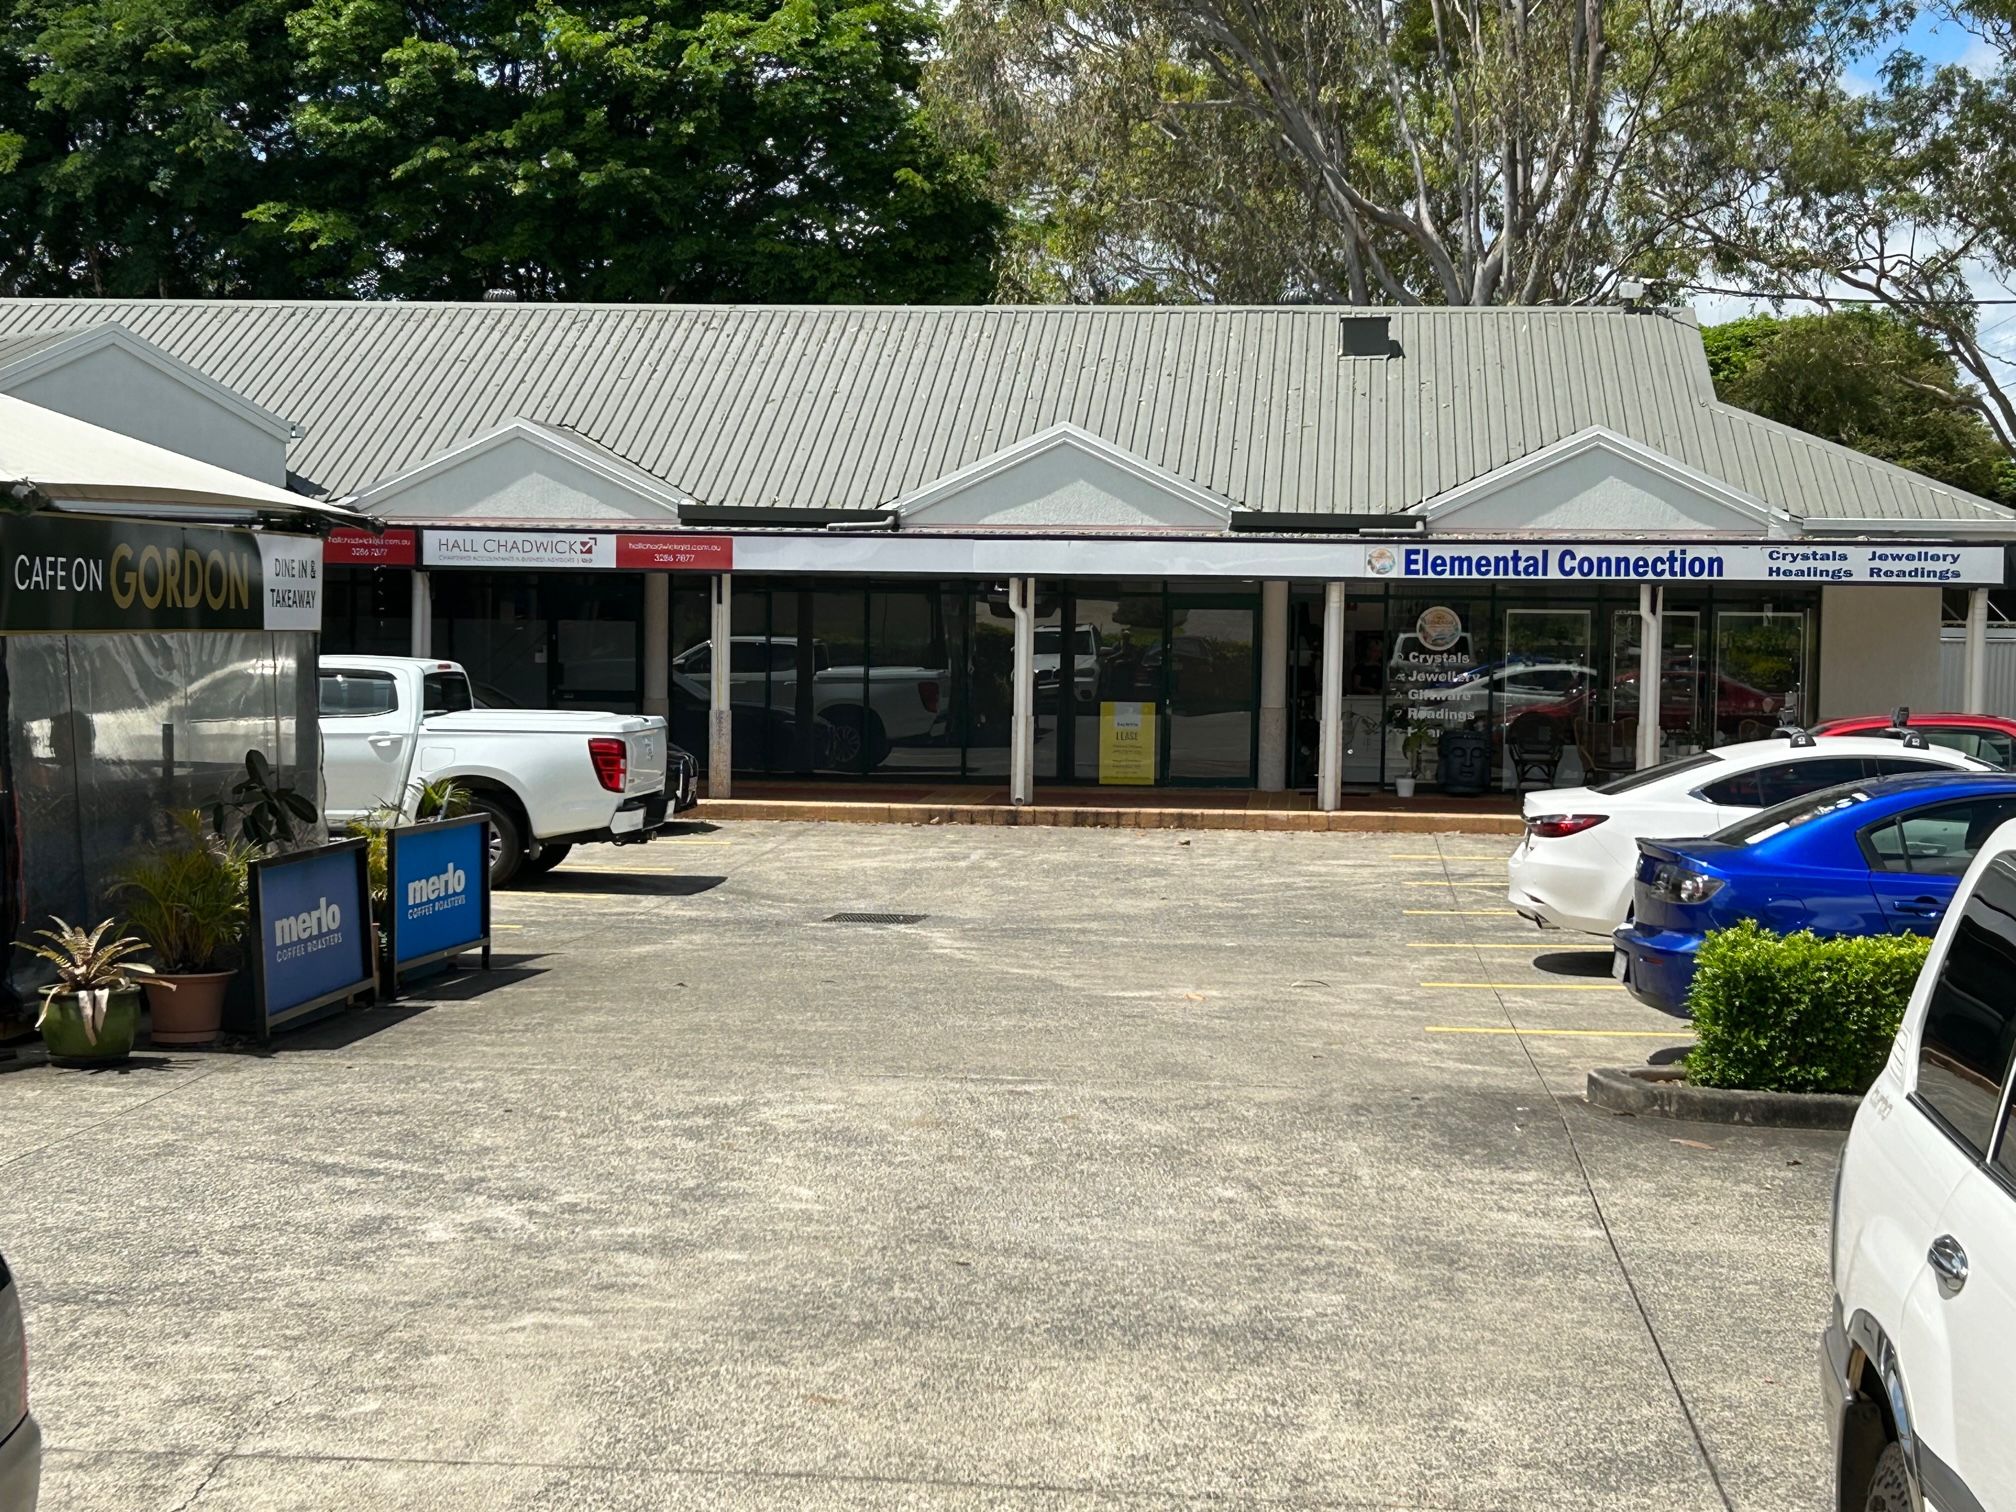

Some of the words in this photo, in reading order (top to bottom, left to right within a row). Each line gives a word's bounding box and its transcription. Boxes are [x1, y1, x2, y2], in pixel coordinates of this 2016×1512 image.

[438, 538, 478, 553] HALL
[483, 539, 577, 555] CHADWICK
[1768, 550, 1848, 562] Crystals
[1868, 551, 1961, 564] Jewellery
[274, 558, 296, 578] DINE
[298, 559, 308, 579] IN
[1404, 549, 1548, 577] Elemental
[1558, 549, 1724, 577] Connection
[1768, 566, 1853, 580] Healings
[1869, 567, 1961, 581] Readings
[14, 554, 67, 590] CAFE
[72, 557, 103, 592] ON
[109, 543, 250, 611] GORDON
[270, 588, 316, 609] TAKEAWAY
[1408, 651, 1470, 665] Crystals
[1407, 707, 1475, 721] Readings
[407, 862, 466, 905] merlo
[407, 903, 433, 920] COFFEE
[434, 894, 466, 913] ROASTERS
[275, 897, 341, 946] merlo
[276, 943, 305, 963] COFFEE
[307, 932, 343, 953] ROASTERS
